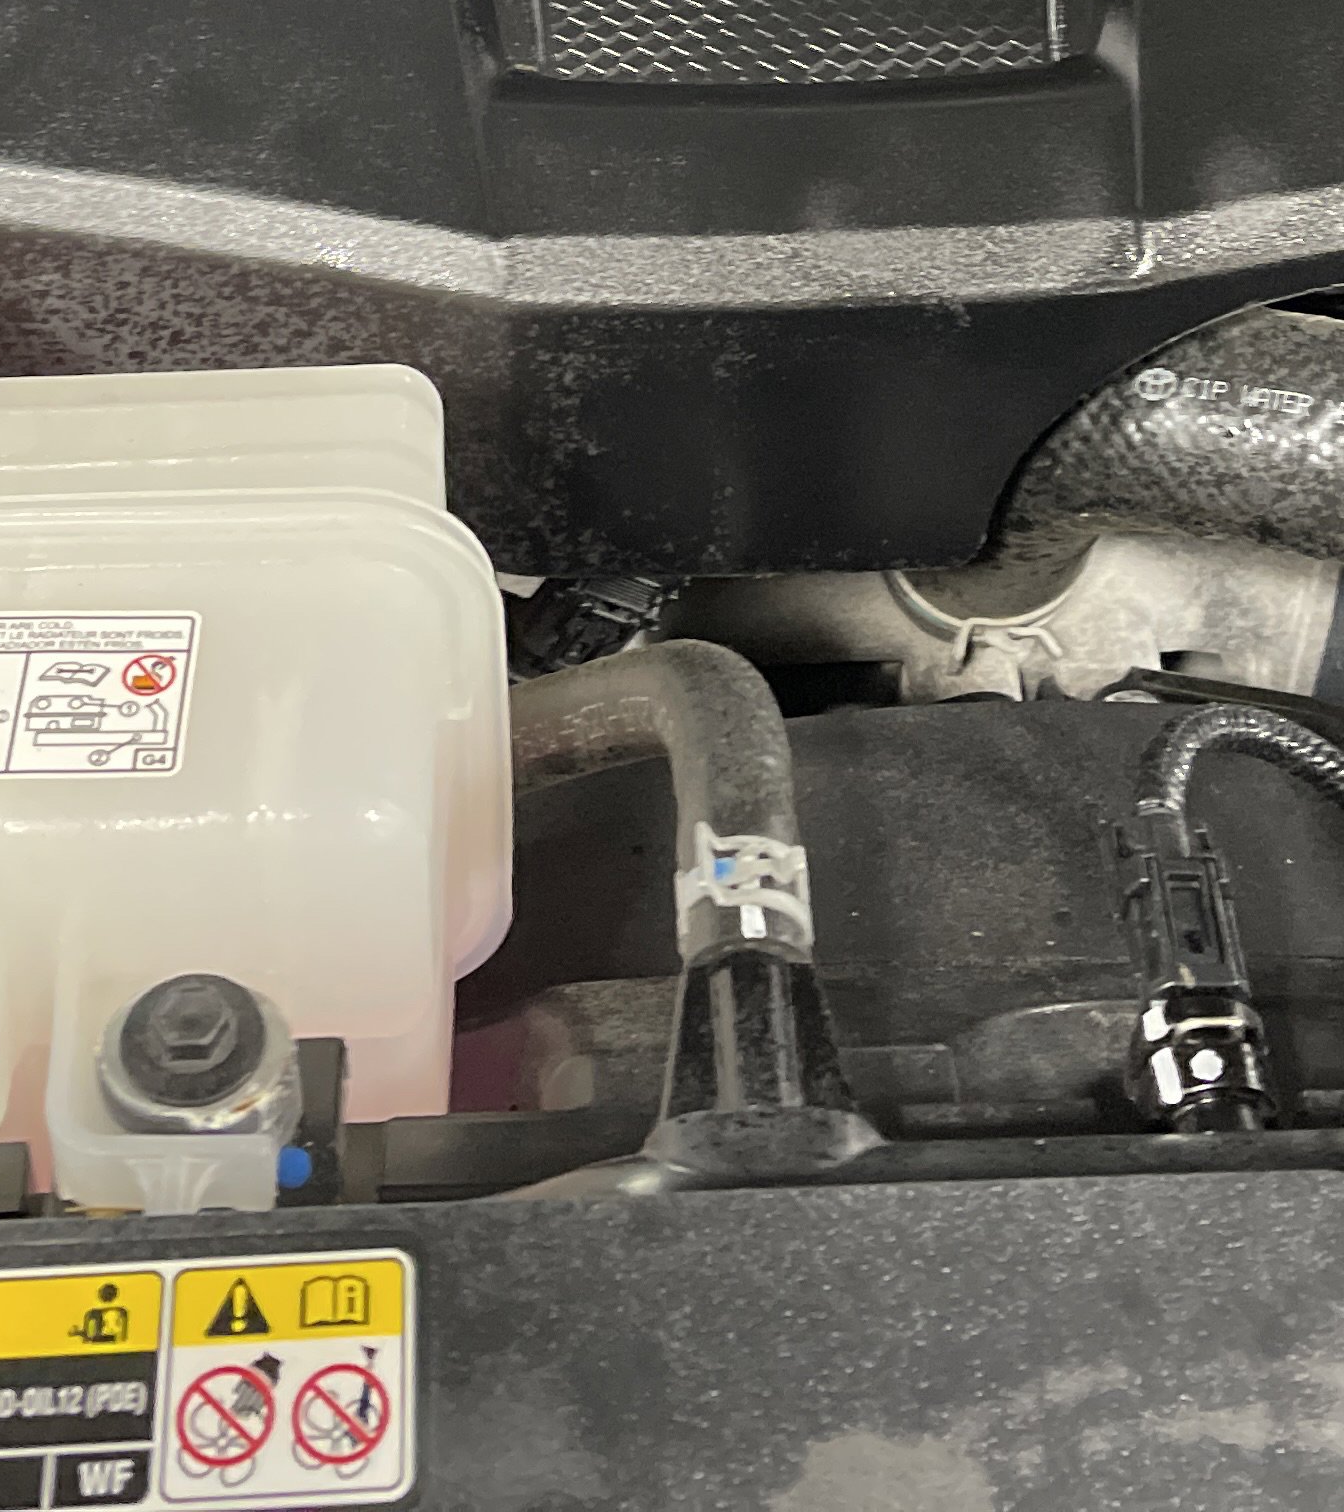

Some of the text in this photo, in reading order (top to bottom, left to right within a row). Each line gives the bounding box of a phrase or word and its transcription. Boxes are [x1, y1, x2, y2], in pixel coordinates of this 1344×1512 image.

[1239, 384, 1316, 417] WATER
[142, 754, 166, 766] G4
[77, 1458, 135, 1497] WF
